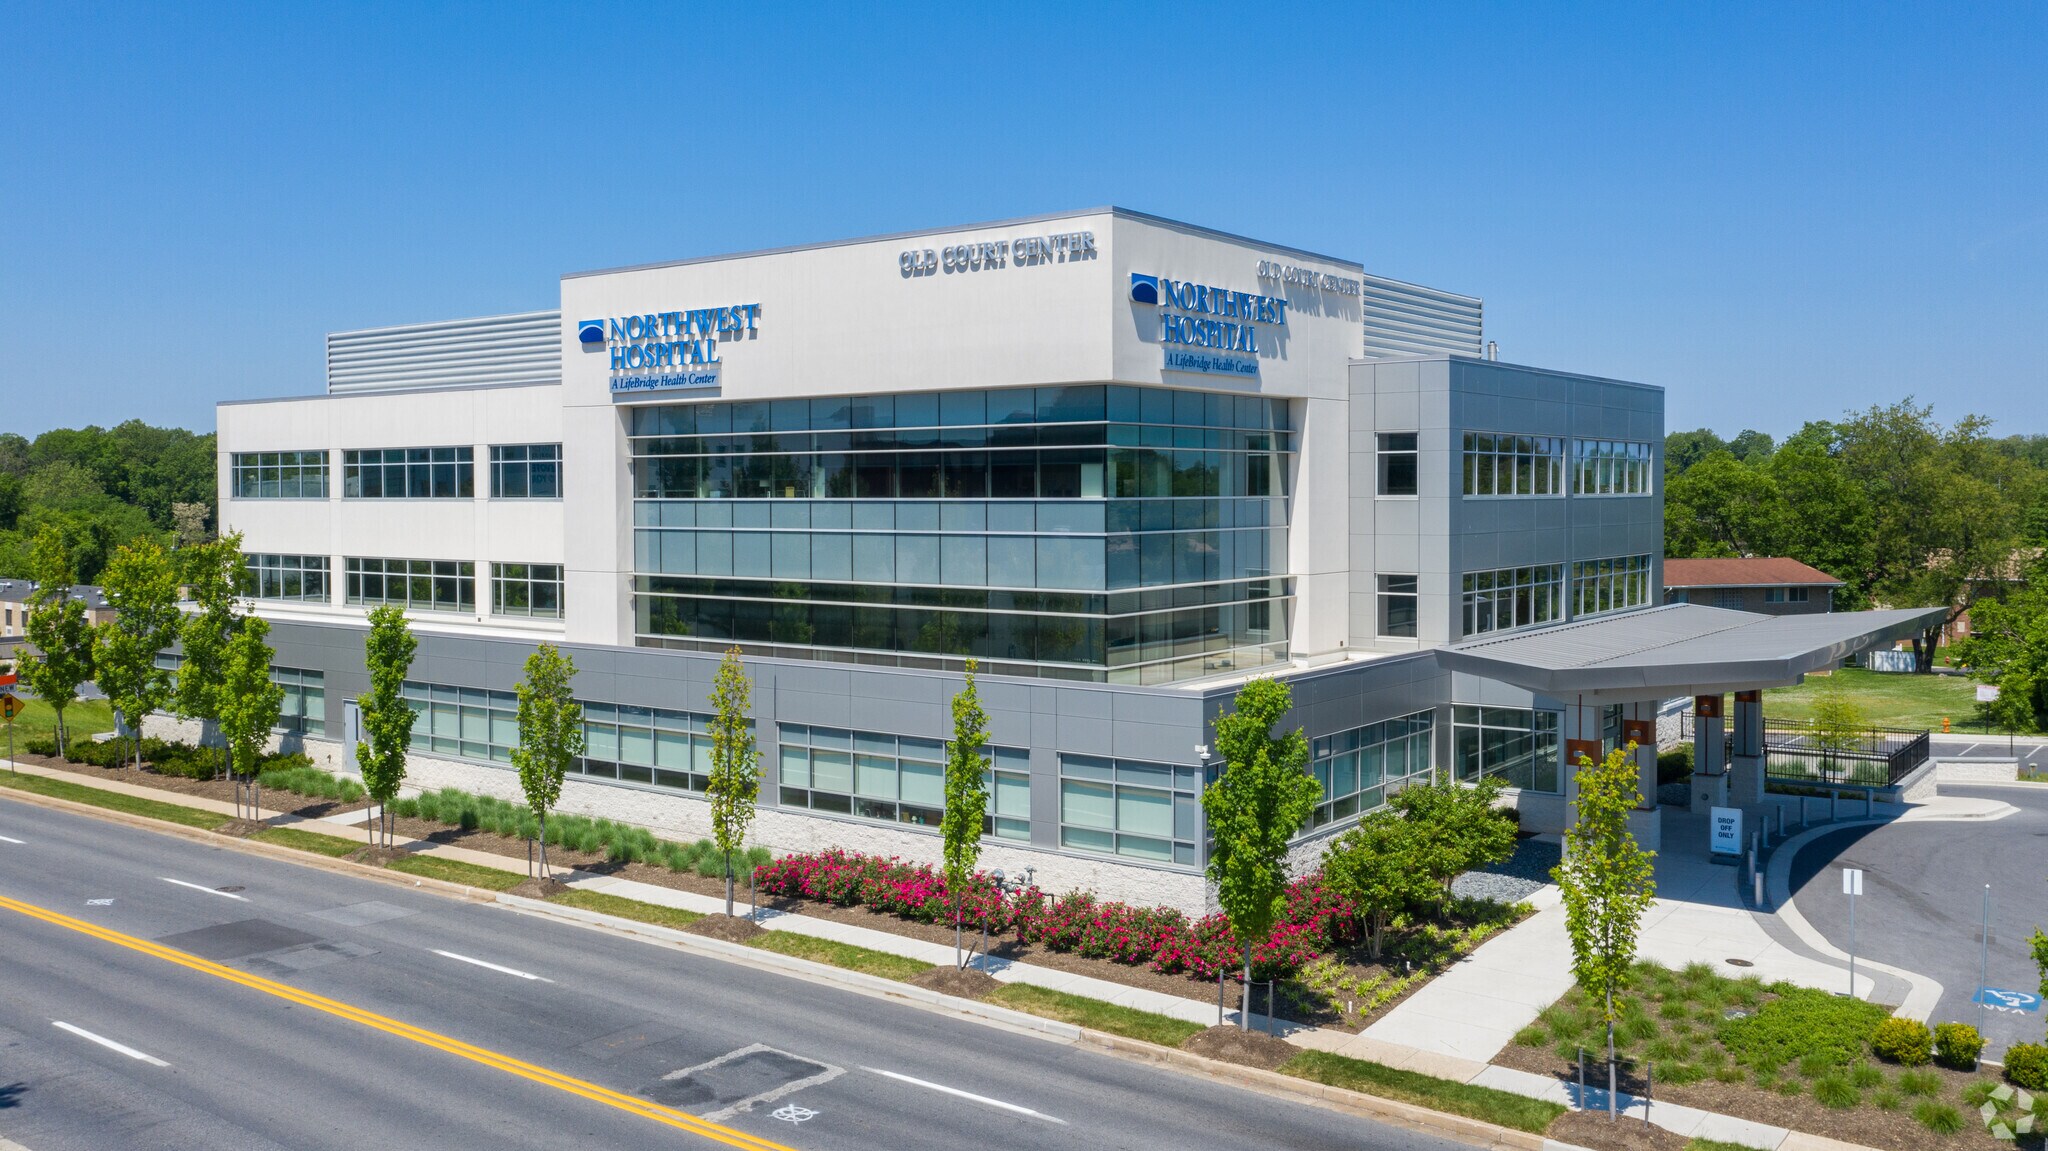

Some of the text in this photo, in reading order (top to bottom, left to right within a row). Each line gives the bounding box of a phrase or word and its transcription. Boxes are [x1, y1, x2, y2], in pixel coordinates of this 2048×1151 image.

[899, 231, 1098, 270] OLD COURT CENTER
[1257, 260, 1361, 295] OLD COURT CENTER
[1162, 279, 1288, 325] NORTHWEST
[609, 303, 760, 342] NORTHWEST
[1161, 313, 1259, 354] HOSPITAL
[609, 338, 720, 371] HOSPITAL
[1166, 353, 1259, 374] A LifeBridge Health Center
[611, 372, 717, 391] A LifeBridge Health Center
[1717, 817, 1735, 825] DROP
[1718, 831, 1735, 839] ONLY
